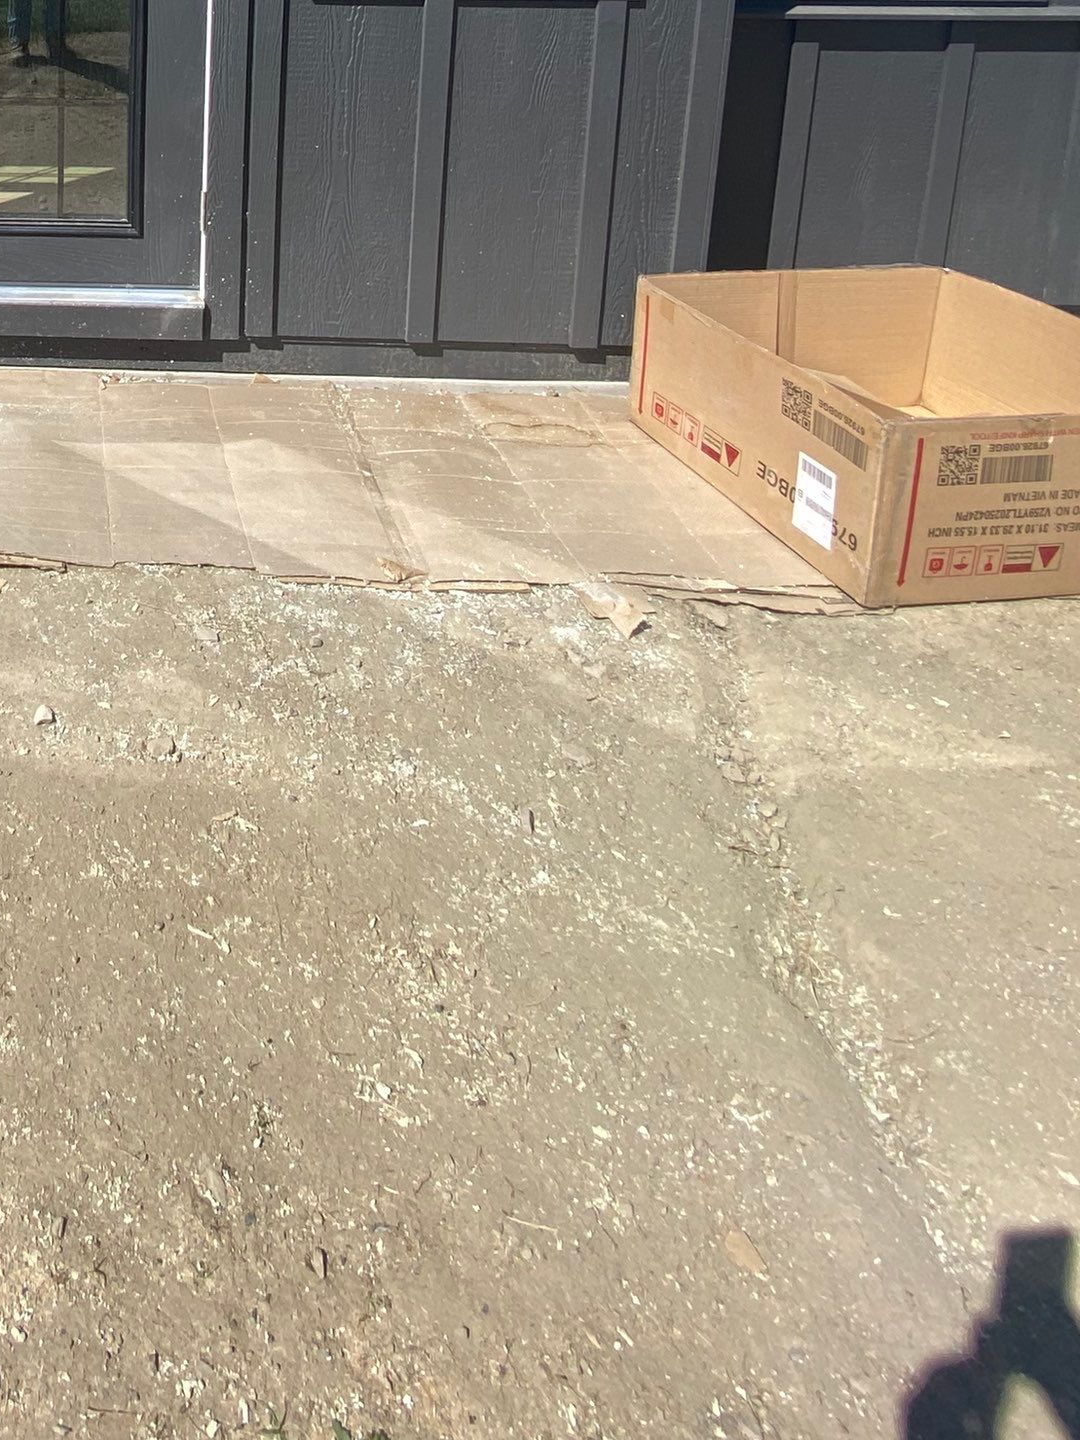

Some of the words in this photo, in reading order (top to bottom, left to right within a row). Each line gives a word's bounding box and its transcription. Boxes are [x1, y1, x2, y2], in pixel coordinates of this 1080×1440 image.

[1003, 490, 1046, 502] VIETNAM
[1048, 490, 1059, 500] IN
[1061, 489, 1080, 500] ADE
[928, 527, 952, 538] INCH
[954, 526, 978, 537] 15.55
[980, 526, 988, 536] X
[990, 524, 1014, 535] 29.33
[1016, 524, 1023, 534] X
[1025, 523, 1049, 534] 31.10
